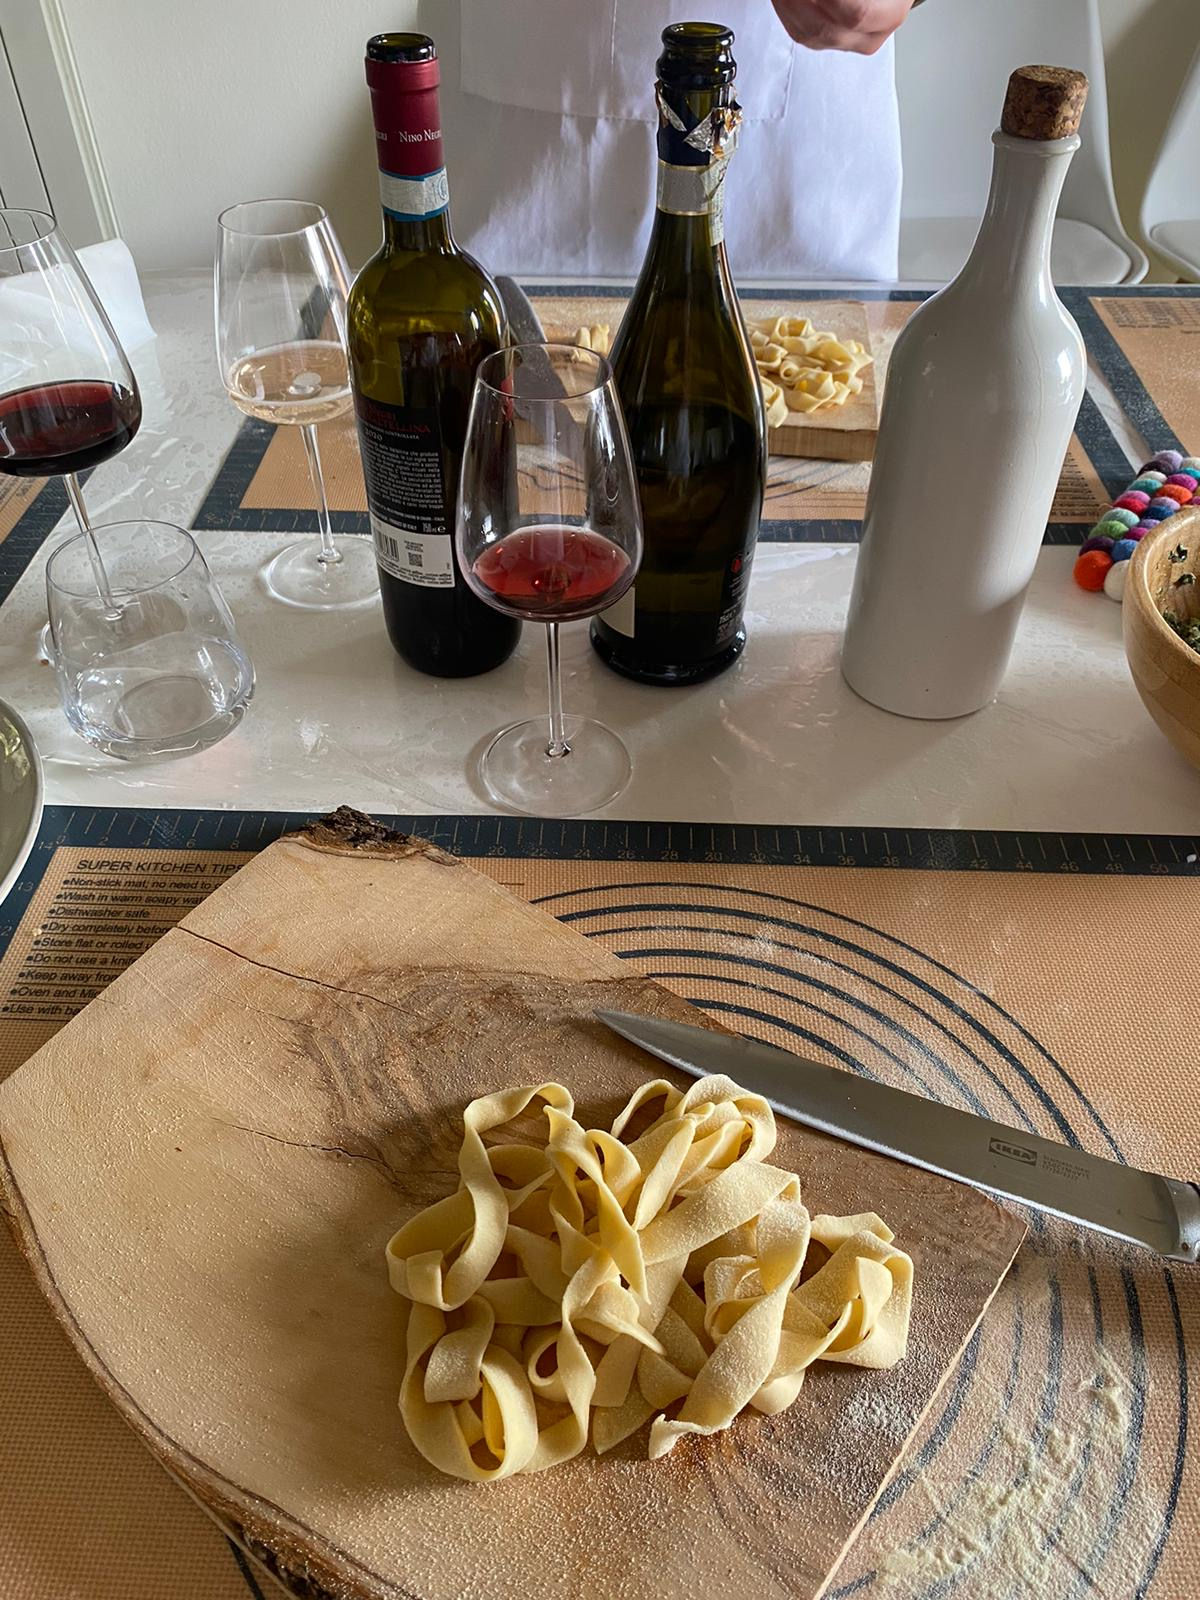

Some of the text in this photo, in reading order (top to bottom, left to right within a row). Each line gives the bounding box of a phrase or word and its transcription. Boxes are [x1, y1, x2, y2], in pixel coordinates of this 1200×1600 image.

[399, 131, 422, 142] NINO
[186, 838, 196, 849] 6
[575, 848, 592, 859] 24
[662, 850, 679, 860] 28
[793, 853, 811, 865] 34
[838, 855, 856, 866] 36
[881, 856, 900, 867] 38
[970, 859, 989, 869] 42
[1060, 861, 1080, 872] 46
[1150, 863, 1169, 873] 50
[77, 859, 131, 871] SUPER
[135, 861, 207, 873] KITCHEN
[69, 877, 122, 888] Non-stick
[151, 881, 167, 889] no
[171, 879, 199, 889] need
[201, 880, 212, 889] to
[63, 892, 95, 901] Wash
[98, 892, 108, 902] in
[110, 894, 142, 903] warm
[145, 895, 177, 905] soapy
[55, 906, 150, 919] Dishwasher safe
[48, 921, 70, 934] Dry
[72, 922, 133, 935] completely
[41, 938, 73, 948] Store
[76, 938, 93, 949] flat
[96, 941, 108, 949] or
[110, 939, 142, 950] rolled
[33, 953, 52, 964] Do
[56, 955, 75, 965] not
[78, 957, 97, 965] use
[25, 969, 57, 982] Keep
[60, 973, 95, 984] away
[18, 987, 49, 997] Oven
[53, 988, 76, 998] and
[10, 1004, 34, 1014] Use
[38, 1004, 62, 1015] with
[995, 1143, 1031, 1161] IKEA
